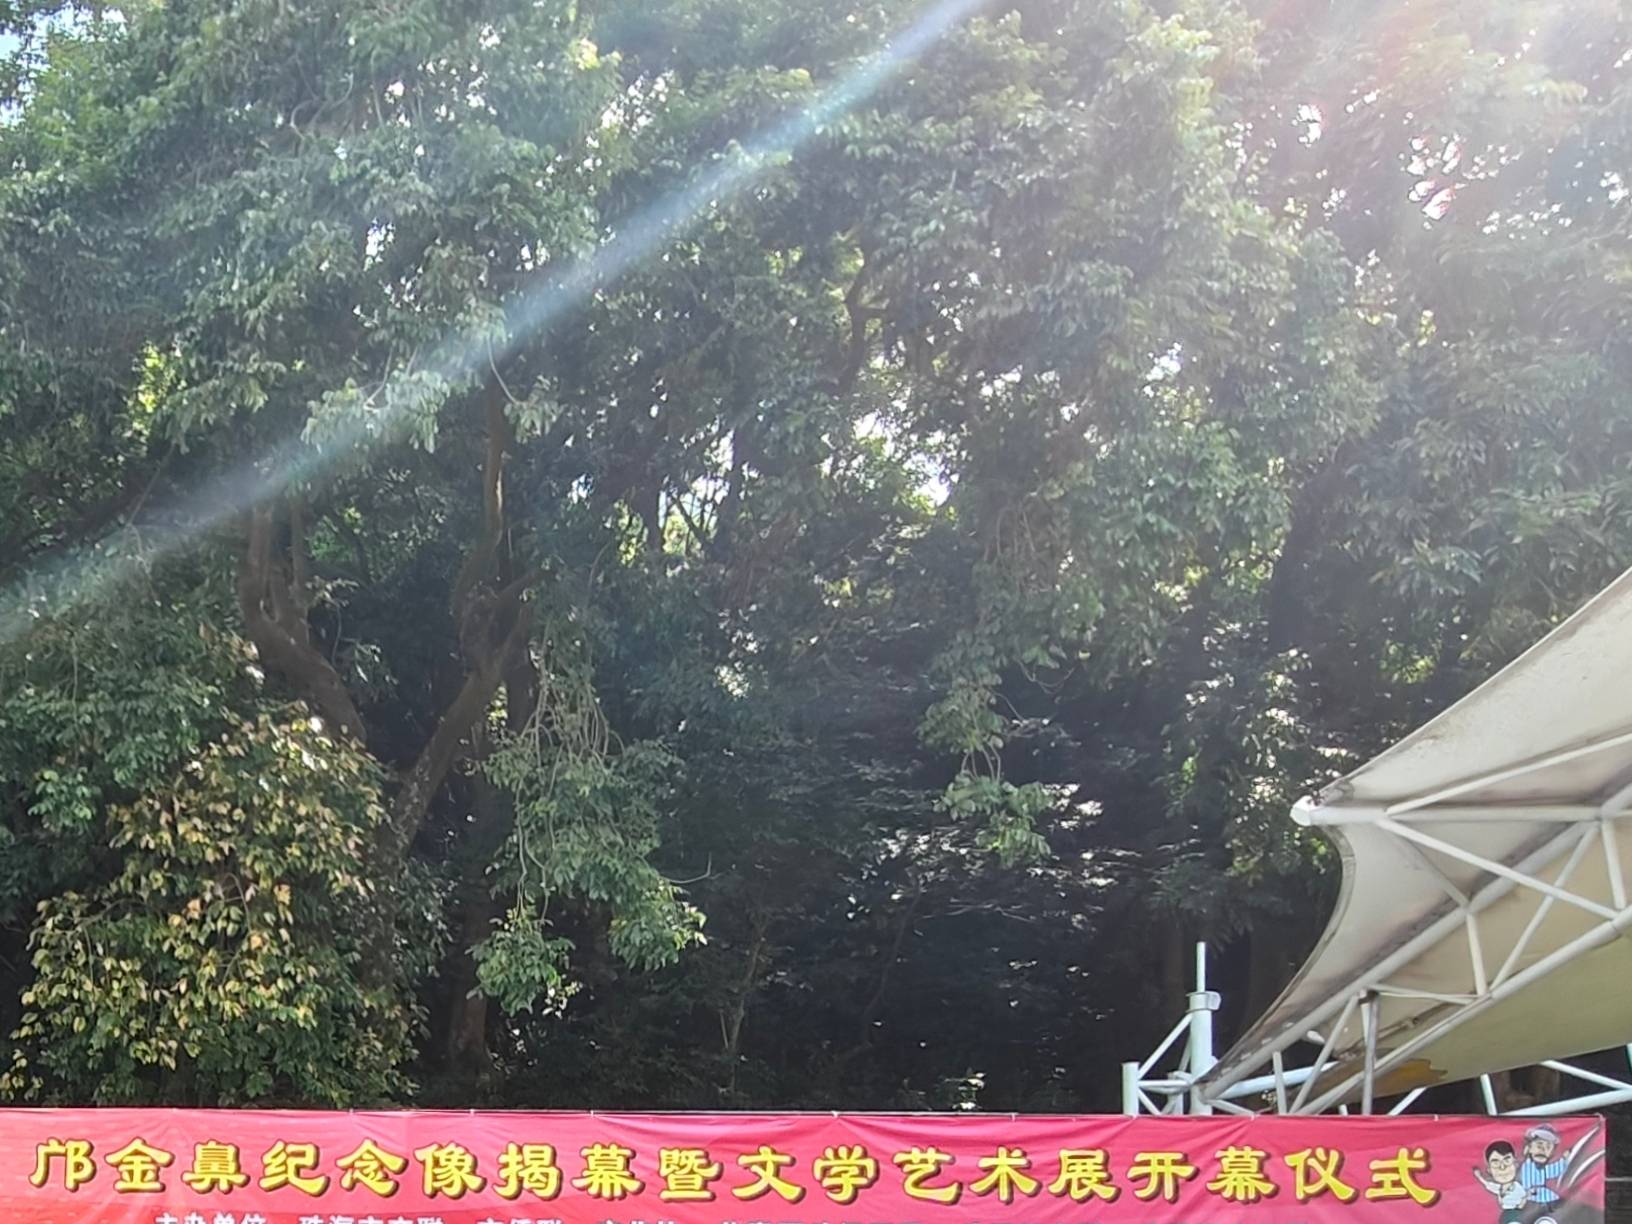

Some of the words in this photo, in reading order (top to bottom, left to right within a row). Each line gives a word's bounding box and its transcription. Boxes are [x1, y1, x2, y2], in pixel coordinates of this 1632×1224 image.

[29, 1136, 1443, 1206] 邝金鼻纪念像揭幕暨文学艺术展开幕仪式
